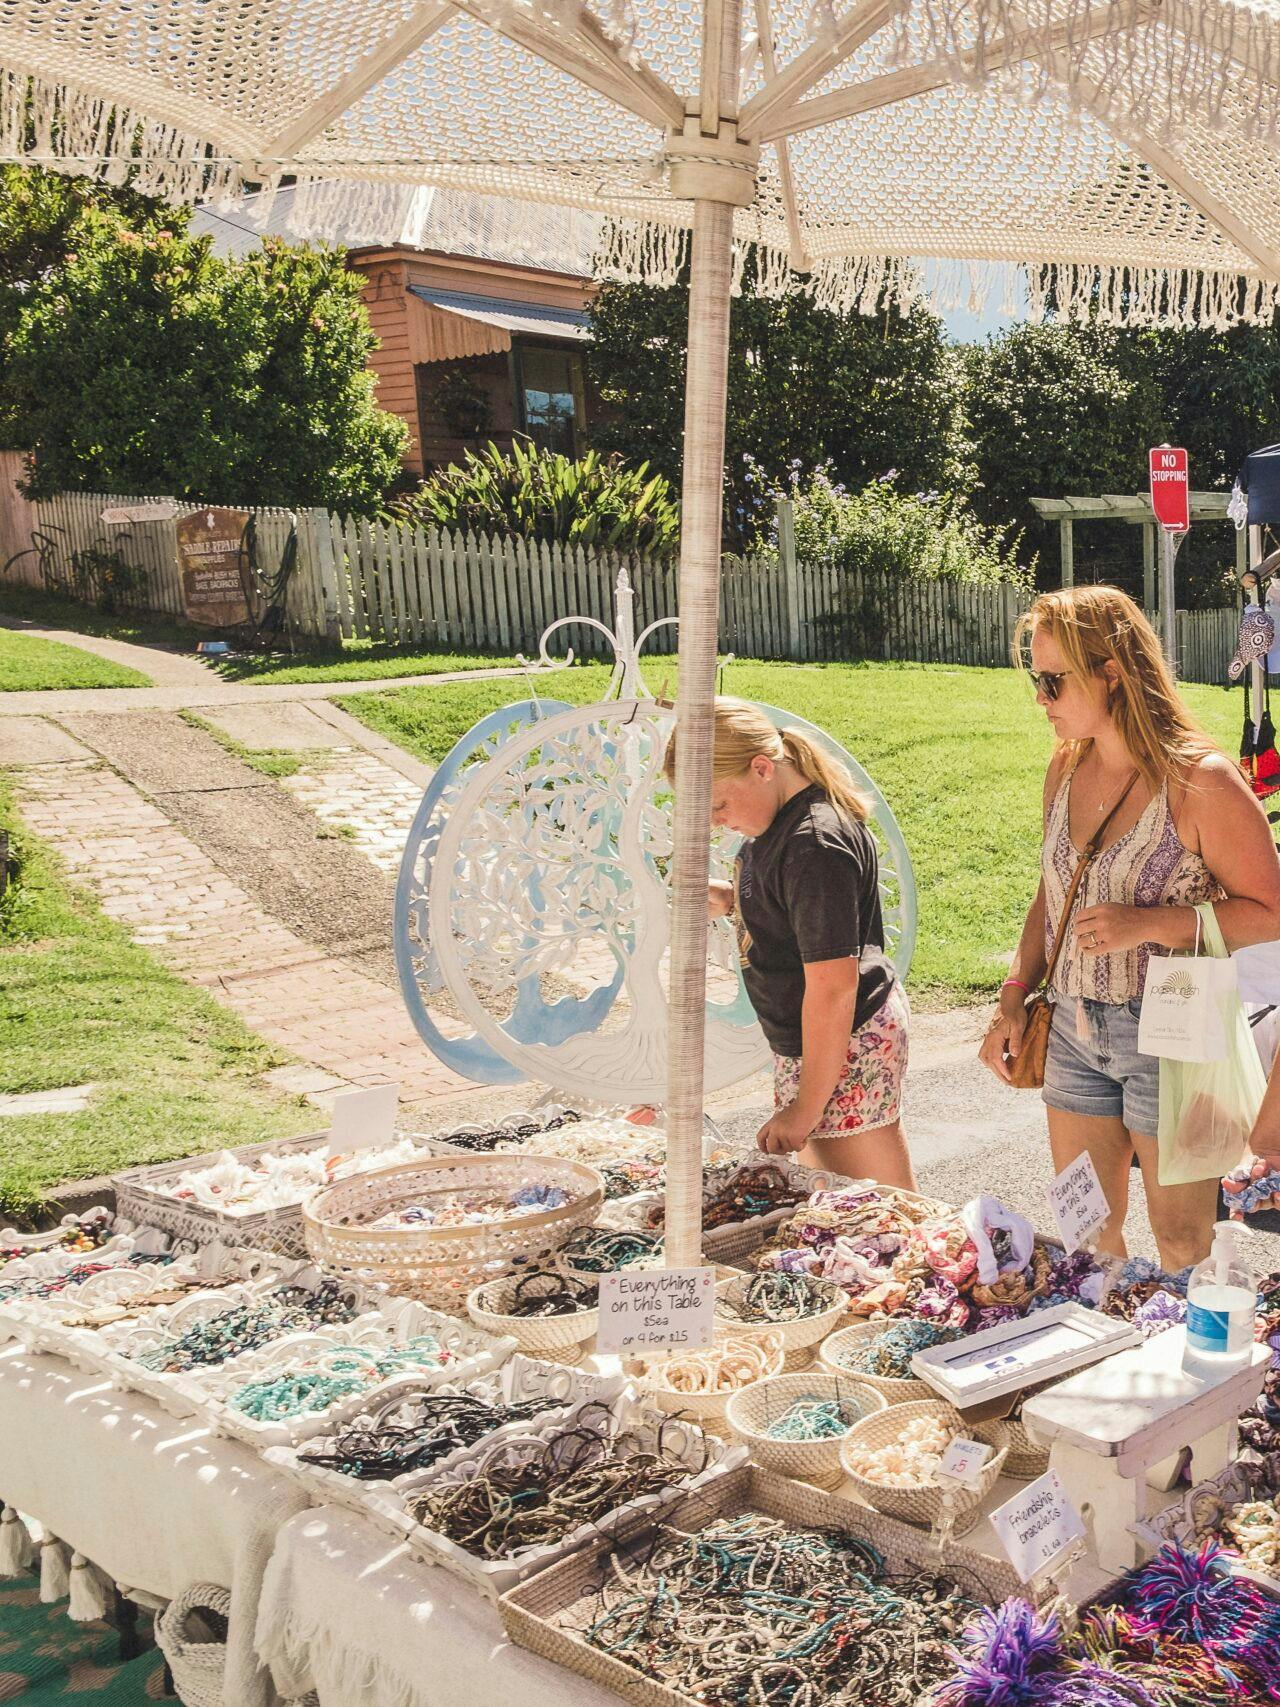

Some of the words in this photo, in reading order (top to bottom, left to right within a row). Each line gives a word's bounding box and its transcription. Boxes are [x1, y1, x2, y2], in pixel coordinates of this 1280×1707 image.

[1161, 454, 1177, 467] NO
[1152, 470, 1187, 482] STOPPING
[619, 1275, 697, 1299] Everything
[611, 1300, 628, 1312] on
[633, 1296, 662, 1312] this
[667, 1293, 702, 1310] Table
[623, 1336, 634, 1345] or
[648, 1332, 666, 1343] for
[669, 1330, 689, 1342] $15
[1008, 1491, 1055, 1528] Friendship
